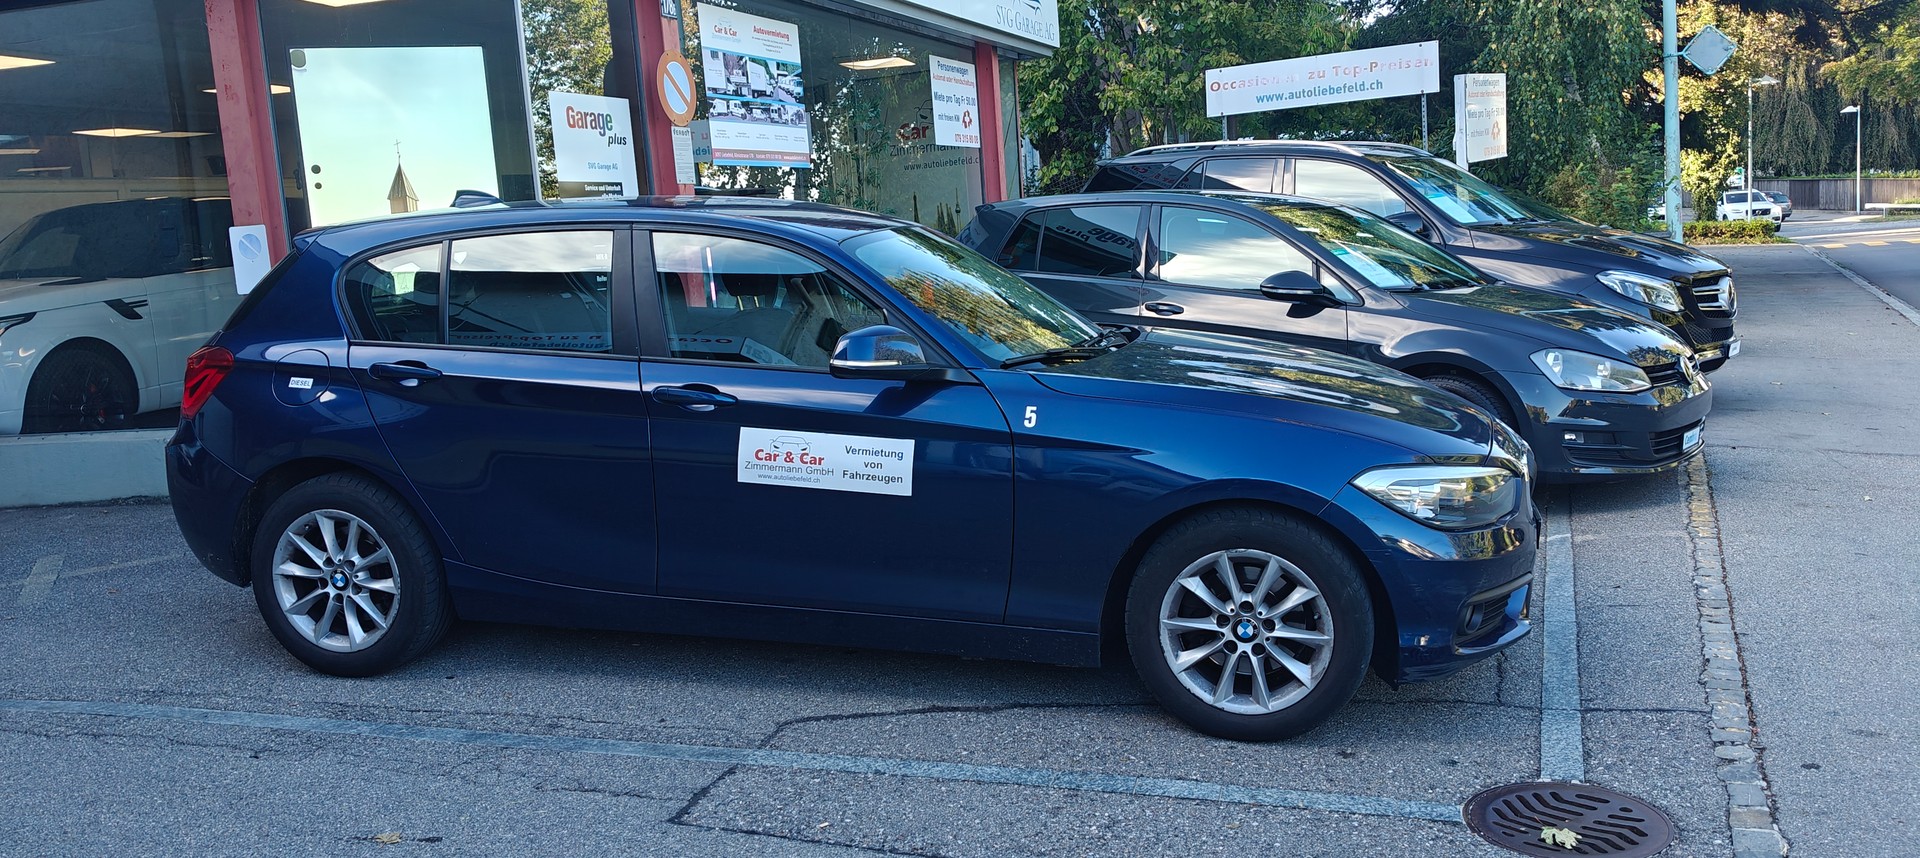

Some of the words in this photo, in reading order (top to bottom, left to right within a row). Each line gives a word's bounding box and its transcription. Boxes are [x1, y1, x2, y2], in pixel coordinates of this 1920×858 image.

[996, 4, 1013, 28] SVG
[1044, 22, 1054, 41] AG
[714, 25, 723, 34] Car
[723, 27, 728, 35] &
[729, 28, 738, 37] Car
[752, 25, 790, 42] Autovermietung
[937, 60, 968, 77] Personenwagen
[1308, 70, 1326, 80] zu
[934, 91, 945, 101] Miete
[1256, 80, 1383, 104] www.autoliebefeld.ch
[566, 106, 613, 136] Garage
[896, 122, 929, 140] Car
[608, 133, 627, 147] plus
[597, 162, 611, 171] Garage
[904, 156, 978, 171] www.autoliebefeld.c
[1024, 406, 1037, 428] 5
[754, 449, 779, 462] Car
[784, 451, 795, 463] &
[800, 453, 824, 466] Car
[845, 445, 904, 461] Vermietung
[744, 461, 802, 474] Zimmermann
[806, 466, 834, 476] GmbH
[864, 461, 883, 470] von
[758, 474, 820, 483] www.autoliebefeld.ch
[842, 470, 903, 485] Fahrzeugen
